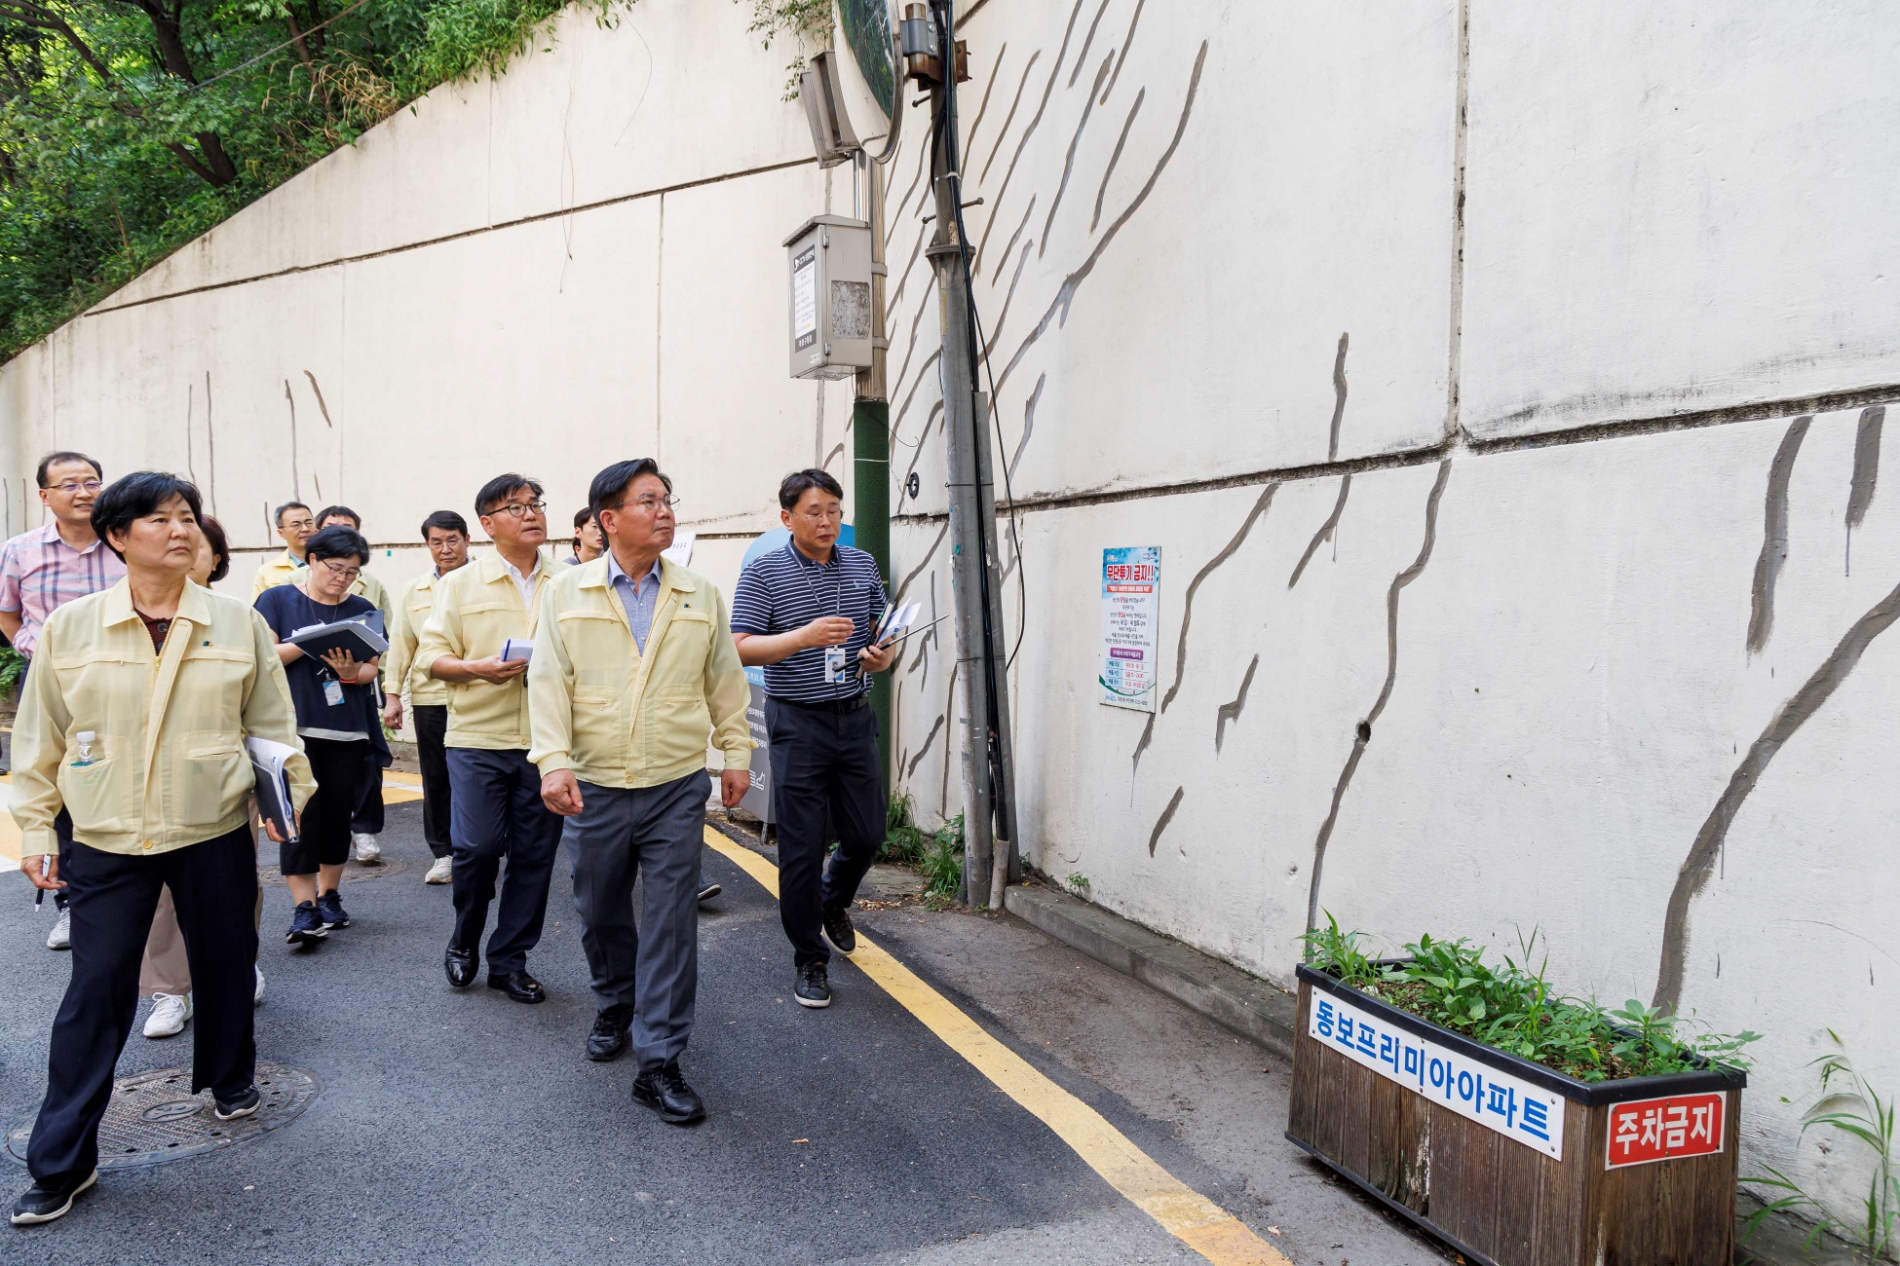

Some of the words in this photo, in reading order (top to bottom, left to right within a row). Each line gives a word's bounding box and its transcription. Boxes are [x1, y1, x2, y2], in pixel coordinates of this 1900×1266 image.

[1106, 564, 1132, 581] 무단투기
[1133, 564, 1154, 582] 금지!!
[1316, 1000, 1550, 1141] 동보프리미아아파트
[1615, 1102, 1714, 1154] 주차금지
